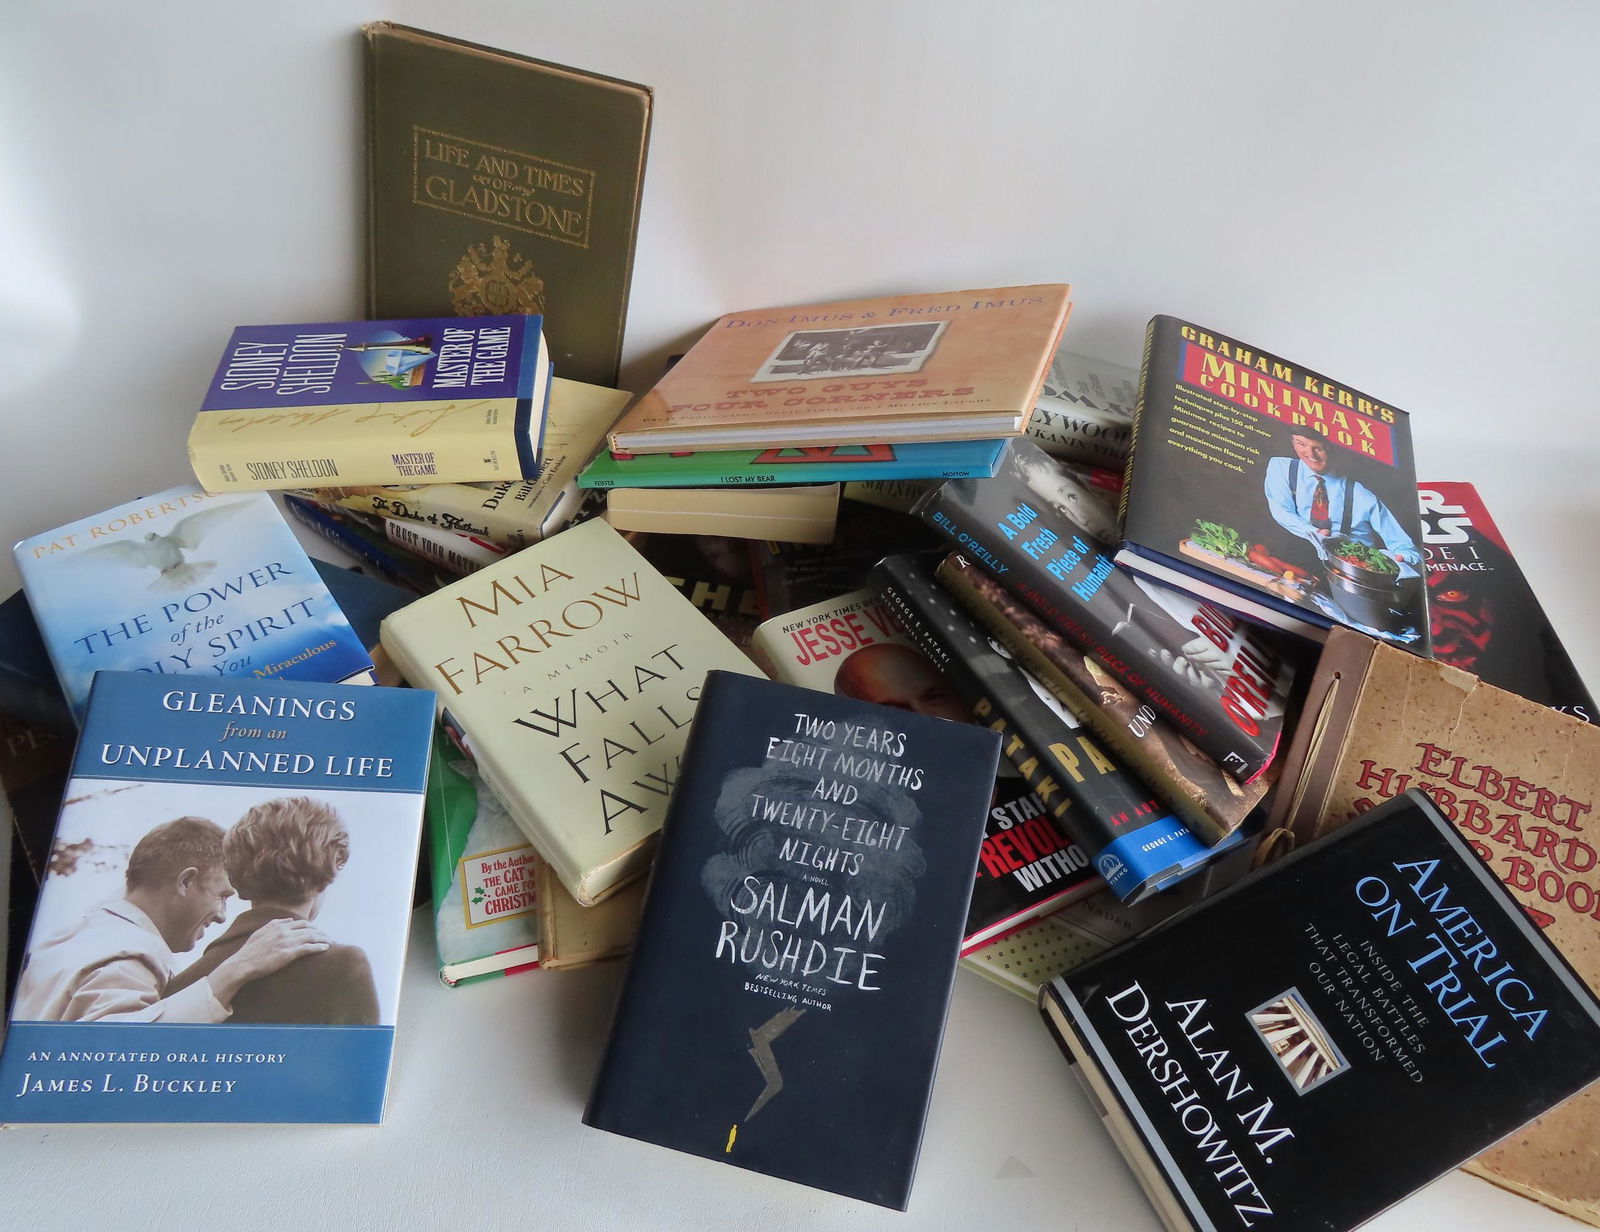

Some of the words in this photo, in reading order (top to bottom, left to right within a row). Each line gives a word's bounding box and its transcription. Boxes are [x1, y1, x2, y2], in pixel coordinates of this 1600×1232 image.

[425, 140, 469, 168] LIFE
[475, 154, 517, 180] AND
[523, 164, 583, 198] TIMES
[425, 176, 582, 237] GLADSTONE
[726, 319, 776, 329] DON
[788, 313, 852, 323] IMUS
[862, 311, 876, 319] &
[890, 304, 960, 317] FRED
[971, 297, 1044, 310] IMUS
[443, 328, 475, 341] OF
[475, 327, 511, 359] GAME
[221, 342, 289, 391] SIDNEY
[277, 333, 347, 395] SHELDON
[432, 343, 473, 388] MASTER
[471, 361, 506, 386] THE
[1181, 325, 1293, 383] GRAHAM
[1304, 375, 1395, 424] KERR'S
[666, 400, 768, 413] FOUR
[784, 387, 974, 406] CORNERS
[725, 386, 807, 399] TWO
[822, 379, 928, 393] GUYS
[1175, 384, 1212, 403] Illustrated
[1213, 400, 1258, 422] step-by-step
[1201, 352, 1376, 440] MINIMAX
[1173, 404, 1207, 422] Minimax
[1209, 420, 1236, 435] recipes
[1174, 395, 1214, 415] techniques
[1214, 412, 1230, 421] plus
[1231, 417, 1243, 427] 150
[1244, 424, 1272, 438] all-new
[1200, 373, 1280, 417] COOK
[1292, 411, 1376, 456] BOOK
[1167, 439, 1208, 459] everything
[1208, 455, 1223, 464] you
[1169, 427, 1185, 437] and
[1185, 433, 1222, 452] maximum
[1223, 448, 1246, 461] flavor
[1247, 457, 1254, 465] in
[1171, 417, 1211, 436] guarantee
[1211, 431, 1246, 449] minimum
[1246, 445, 1260, 456] risk
[246, 461, 286, 481] SIDNEY
[287, 459, 339, 479] SHELDON
[392, 453, 425, 466] MASTER
[425, 452, 435, 463] OF
[397, 466, 412, 477] THE
[412, 465, 437, 476] GAME
[515, 485, 533, 501] Bill
[372, 497, 390, 511] The
[391, 501, 424, 522] Duke
[427, 513, 438, 525] of
[441, 512, 490, 537] Flatbush
[997, 522, 1018, 541] A
[1006, 502, 1039, 530] Bold
[32, 534, 77, 559] PAT
[389, 522, 419, 546] TRUST
[422, 538, 444, 558] YOUR
[933, 512, 957, 536] BILL
[958, 533, 1009, 575] O'REILLY
[1020, 528, 1059, 561] Fresh
[1046, 551, 1082, 582] Piece
[1073, 535, 1091, 555] of
[1469, 546, 1479, 559] I
[1425, 562, 1487, 572] MENACE
[73, 614, 153, 655] THE
[160, 562, 295, 623] POWER
[456, 563, 574, 628] MIA
[170, 626, 188, 646] of
[192, 614, 225, 635] the
[208, 597, 315, 657] SPIRIT
[434, 571, 641, 695] FARROW
[782, 621, 804, 634] NEW
[806, 612, 832, 625] YORK
[833, 603, 862, 617] TIMES
[887, 587, 914, 619] GEORGE
[915, 621, 921, 631] E.
[924, 632, 950, 663] PATAKI
[547, 632, 633, 681] MEMOIR
[791, 613, 874, 666] JESSE
[212, 656, 251, 677] You
[254, 639, 337, 681] Miraculous
[1094, 645, 1130, 676] PIECE
[1127, 672, 1145, 687] OF
[162, 690, 356, 721] GLEANINGS
[513, 644, 685, 739] WHAT
[220, 721, 263, 742] from
[267, 728, 287, 740] an
[794, 713, 835, 740] TWO
[842, 721, 907, 757] YEARS
[1128, 704, 1156, 738] UND
[100, 743, 315, 775] UNPLANNED
[325, 756, 393, 778] LIFE
[766, 736, 832, 769] EIGHT
[833, 754, 924, 791] MONTHS
[812, 776, 858, 805] AND
[1415, 742, 1592, 831] ELBERT
[751, 794, 910, 851] TWENTY-EIGHT
[1110, 812, 1129, 826] AN
[778, 837, 864, 876] NIGHTS
[1141, 837, 1167, 852] GEORGE
[481, 862, 492, 874] By
[493, 860, 507, 870] the
[483, 876, 501, 888] THE
[504, 867, 525, 883] CAT
[802, 873, 809, 881] A
[809, 876, 829, 886] NOVEL
[1013, 844, 1090, 893] WITHO
[1110, 868, 1128, 885] VIKING
[495, 883, 520, 897] CAME
[730, 876, 887, 942] SALMAN
[715, 920, 886, 991] RUSHDIE
[1392, 859, 1548, 1042] AMERICA
[755, 973, 778, 984] NEW
[779, 977, 799, 990] YORK
[802, 983, 827, 996] TIMES
[1355, 876, 1417, 937] ON
[1406, 932, 1507, 1070] TRIAL
[1359, 940, 1402, 992] INSIDE
[1402, 994, 1430, 1029] THE
[744, 982, 797, 1003] BESTSELLING
[802, 997, 832, 1012] AUTHOR
[1304, 923, 1338, 963] THAT
[1337, 966, 1424, 1084] TRANSFORMED
[1309, 962, 1336, 995] OUR
[1335, 1000, 1385, 1062] NATION
[1333, 933, 1370, 984] LEGAL
[1372, 987, 1426, 1054] BATTLES
[28, 1051, 51, 1062] AN
[57, 1051, 160, 1062] ANNOTATED
[166, 1052, 209, 1063] ORAL
[215, 1053, 287, 1064] HISTORY
[102, 1074, 124, 1093] L.
[1165, 998, 1254, 1102] ALAN
[1236, 1096, 1295, 1165] M.
[1105, 980, 1274, 1229] DERSHOWITZ
